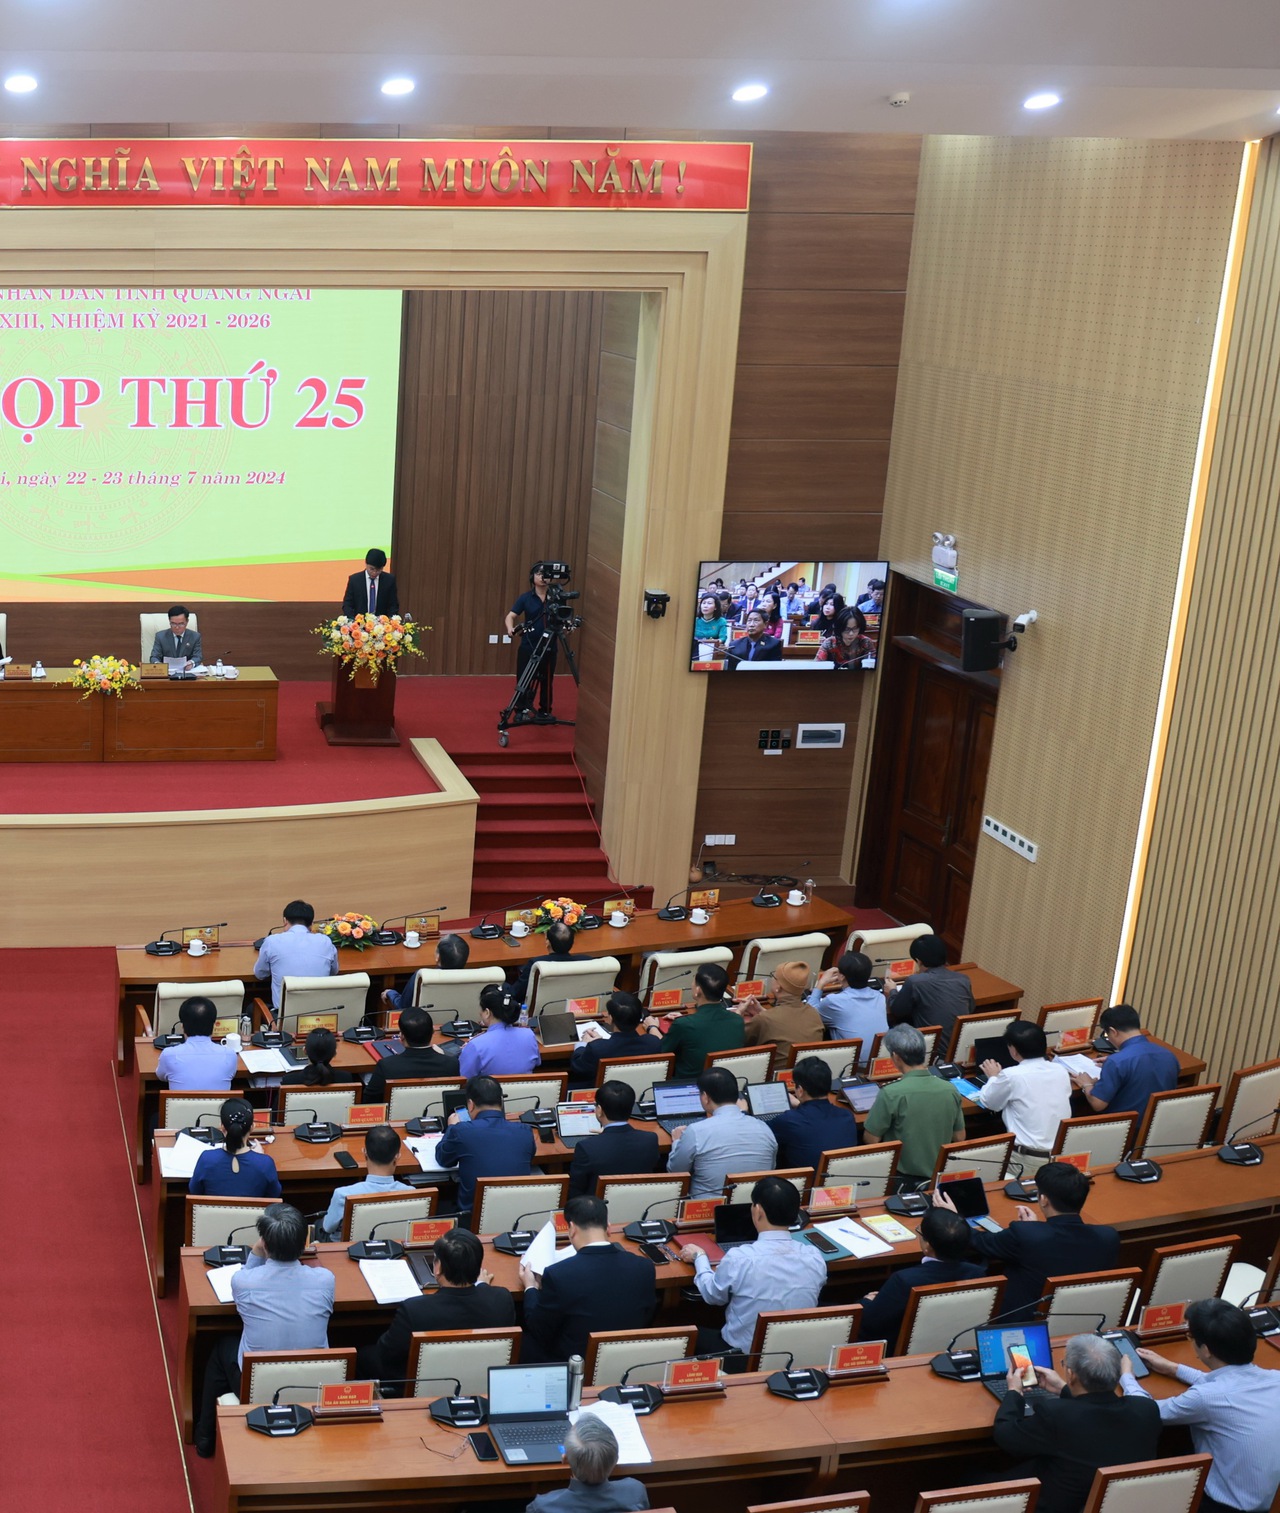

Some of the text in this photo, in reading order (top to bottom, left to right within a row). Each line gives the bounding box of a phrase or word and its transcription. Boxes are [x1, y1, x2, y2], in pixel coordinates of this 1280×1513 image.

[21, 147, 158, 192] NGHĨA
[180, 146, 285, 199] VIỆT
[304, 157, 401, 193] NAM
[421, 146, 550, 193] MUÔN
[570, 146, 665, 194] NĂM
[676, 160, 688, 194] !
[51, 308, 125, 332] NHIỆM
[132, 307, 161, 330] KỲ
[165, 312, 209, 330] 2021
[226, 312, 271, 330] 2026
[118, 358, 281, 431] THỨ
[293, 375, 369, 431] 25
[17, 471, 61, 488] ngày
[65, 471, 87, 485] 22
[102, 471, 123, 485] 23
[128, 470, 182, 488] tháng
[187, 471, 197, 485] 7
[201, 471, 241, 485] năm
[245, 471, 286, 485] 2024
